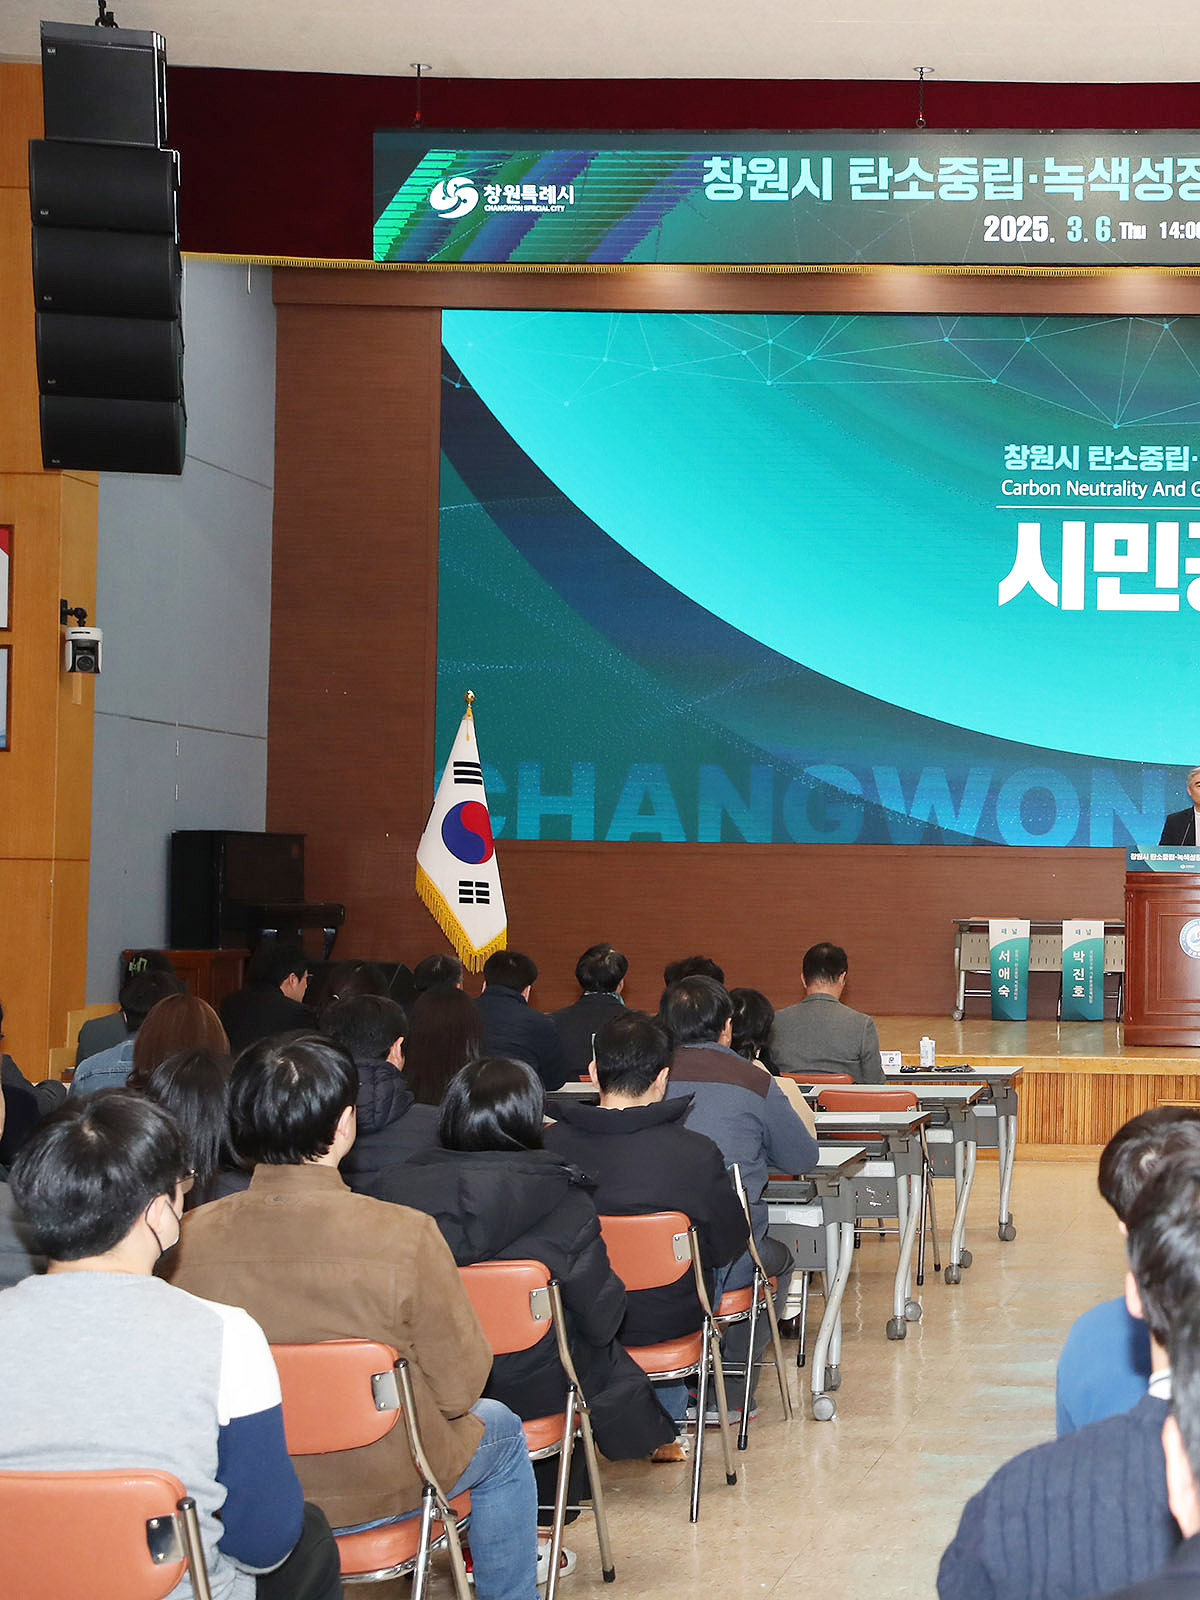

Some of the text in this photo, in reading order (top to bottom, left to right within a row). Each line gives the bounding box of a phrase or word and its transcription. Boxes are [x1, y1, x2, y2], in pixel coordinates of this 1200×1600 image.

[702, 156, 833, 201] 창원시
[483, 184, 574, 205] 창원특례시
[483, 205, 566, 213] CHANGWON SPECIAL CITY
[983, 214, 1055, 243] 2025.
[1118, 221, 1147, 240] Thu
[1003, 444, 1080, 471] 창원시
[1001, 479, 1061, 496] Carbon
[1066, 479, 1148, 500] Neutrality
[1152, 480, 1186, 497] And
[998, 949, 1011, 998] 서애숙
[1071, 950, 1086, 998] 박진호
